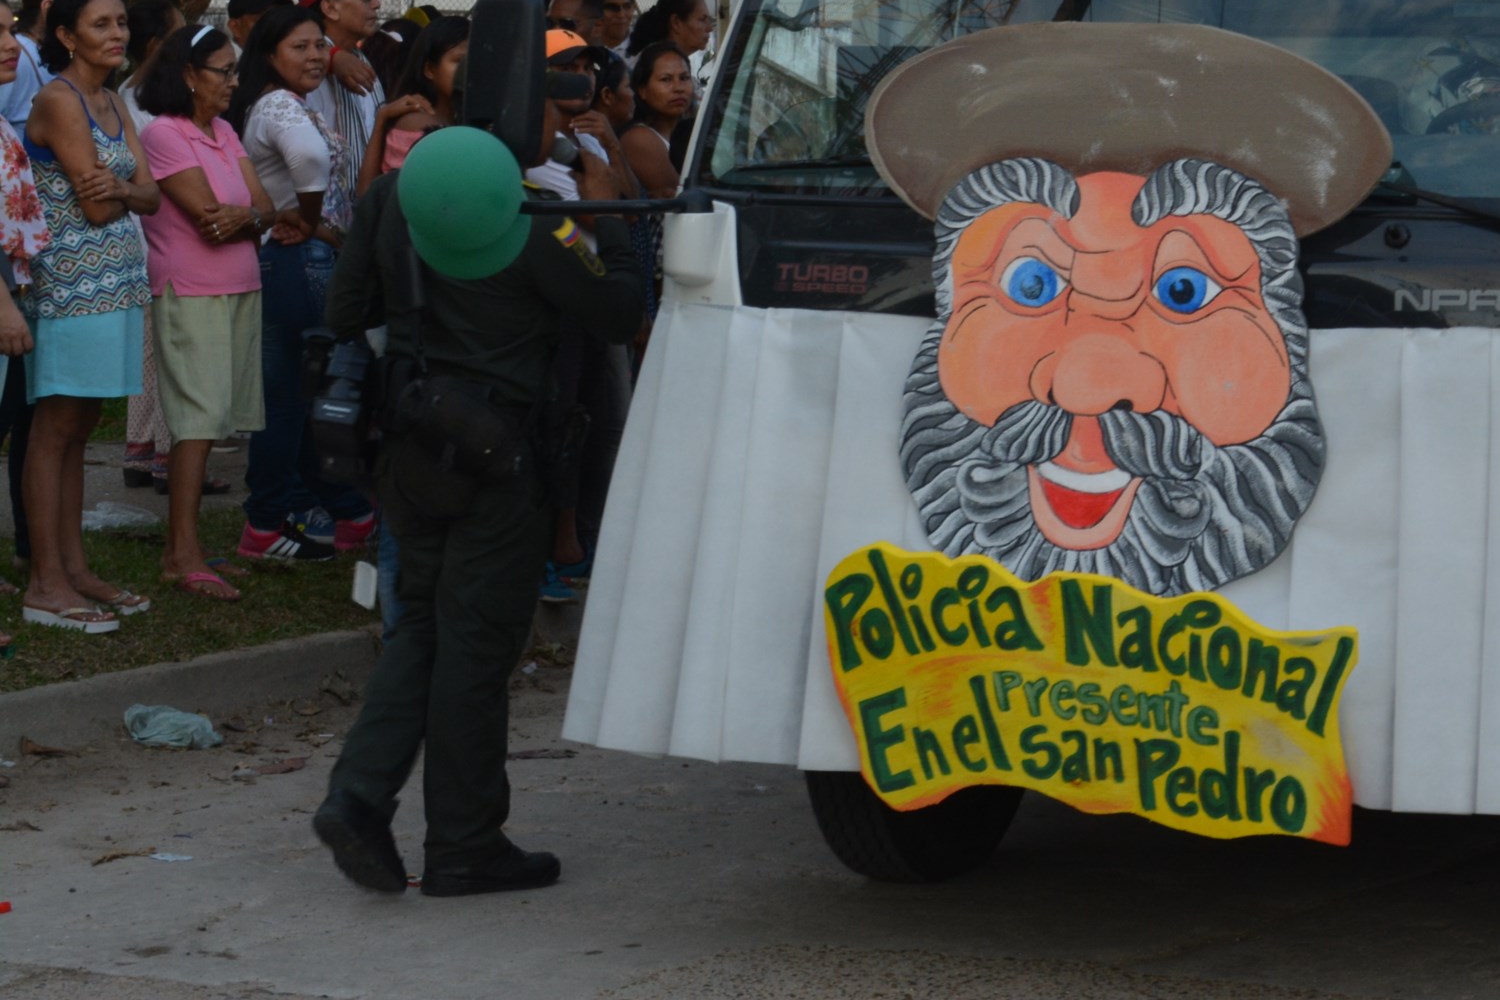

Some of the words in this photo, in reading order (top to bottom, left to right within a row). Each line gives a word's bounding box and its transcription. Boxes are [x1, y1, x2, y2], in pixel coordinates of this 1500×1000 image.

[777, 263, 869, 283] TURBO
[792, 282, 867, 294] SPEED
[1060, 578, 1354, 738] Nacional
[992, 670, 1220, 746] Presente
[1134, 730, 1307, 834] Pedro
